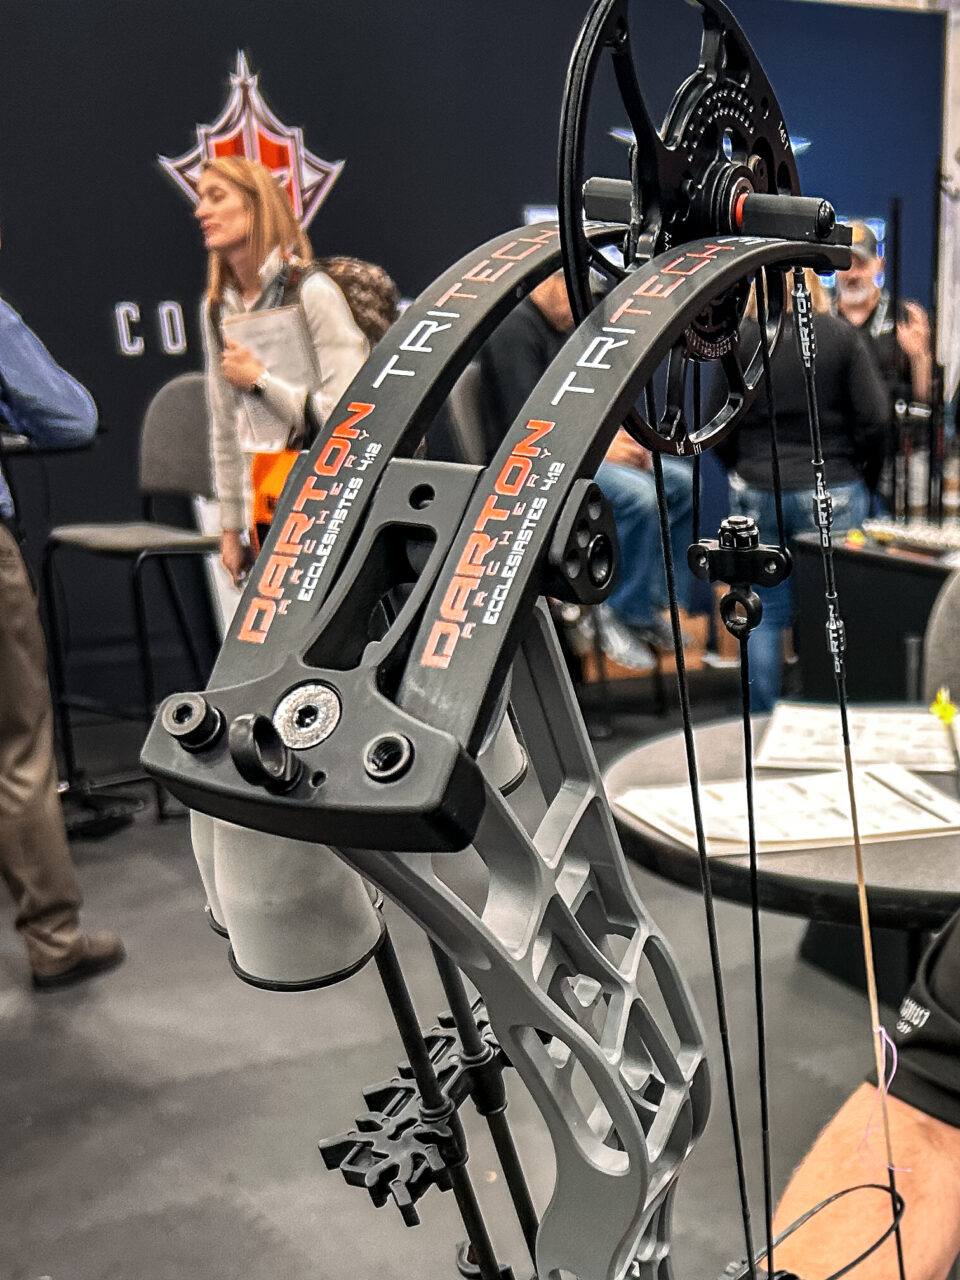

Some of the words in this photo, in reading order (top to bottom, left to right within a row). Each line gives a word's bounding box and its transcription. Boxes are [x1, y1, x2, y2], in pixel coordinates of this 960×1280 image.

[372, 229, 560, 389] TRITECH
[551, 244, 735, 406] TRITECH
[237, 401, 376, 644] DARTON
[277, 429, 370, 615] ARCHERY
[298, 477, 363, 602] ECCLESIASTES
[357, 443, 382, 471] 4:12
[420, 419, 556, 669] DARTON
[461, 448, 552, 639] ARCHERY
[482, 497, 548, 625] ECCLESIASTES
[540, 461, 565, 491] 4:12
